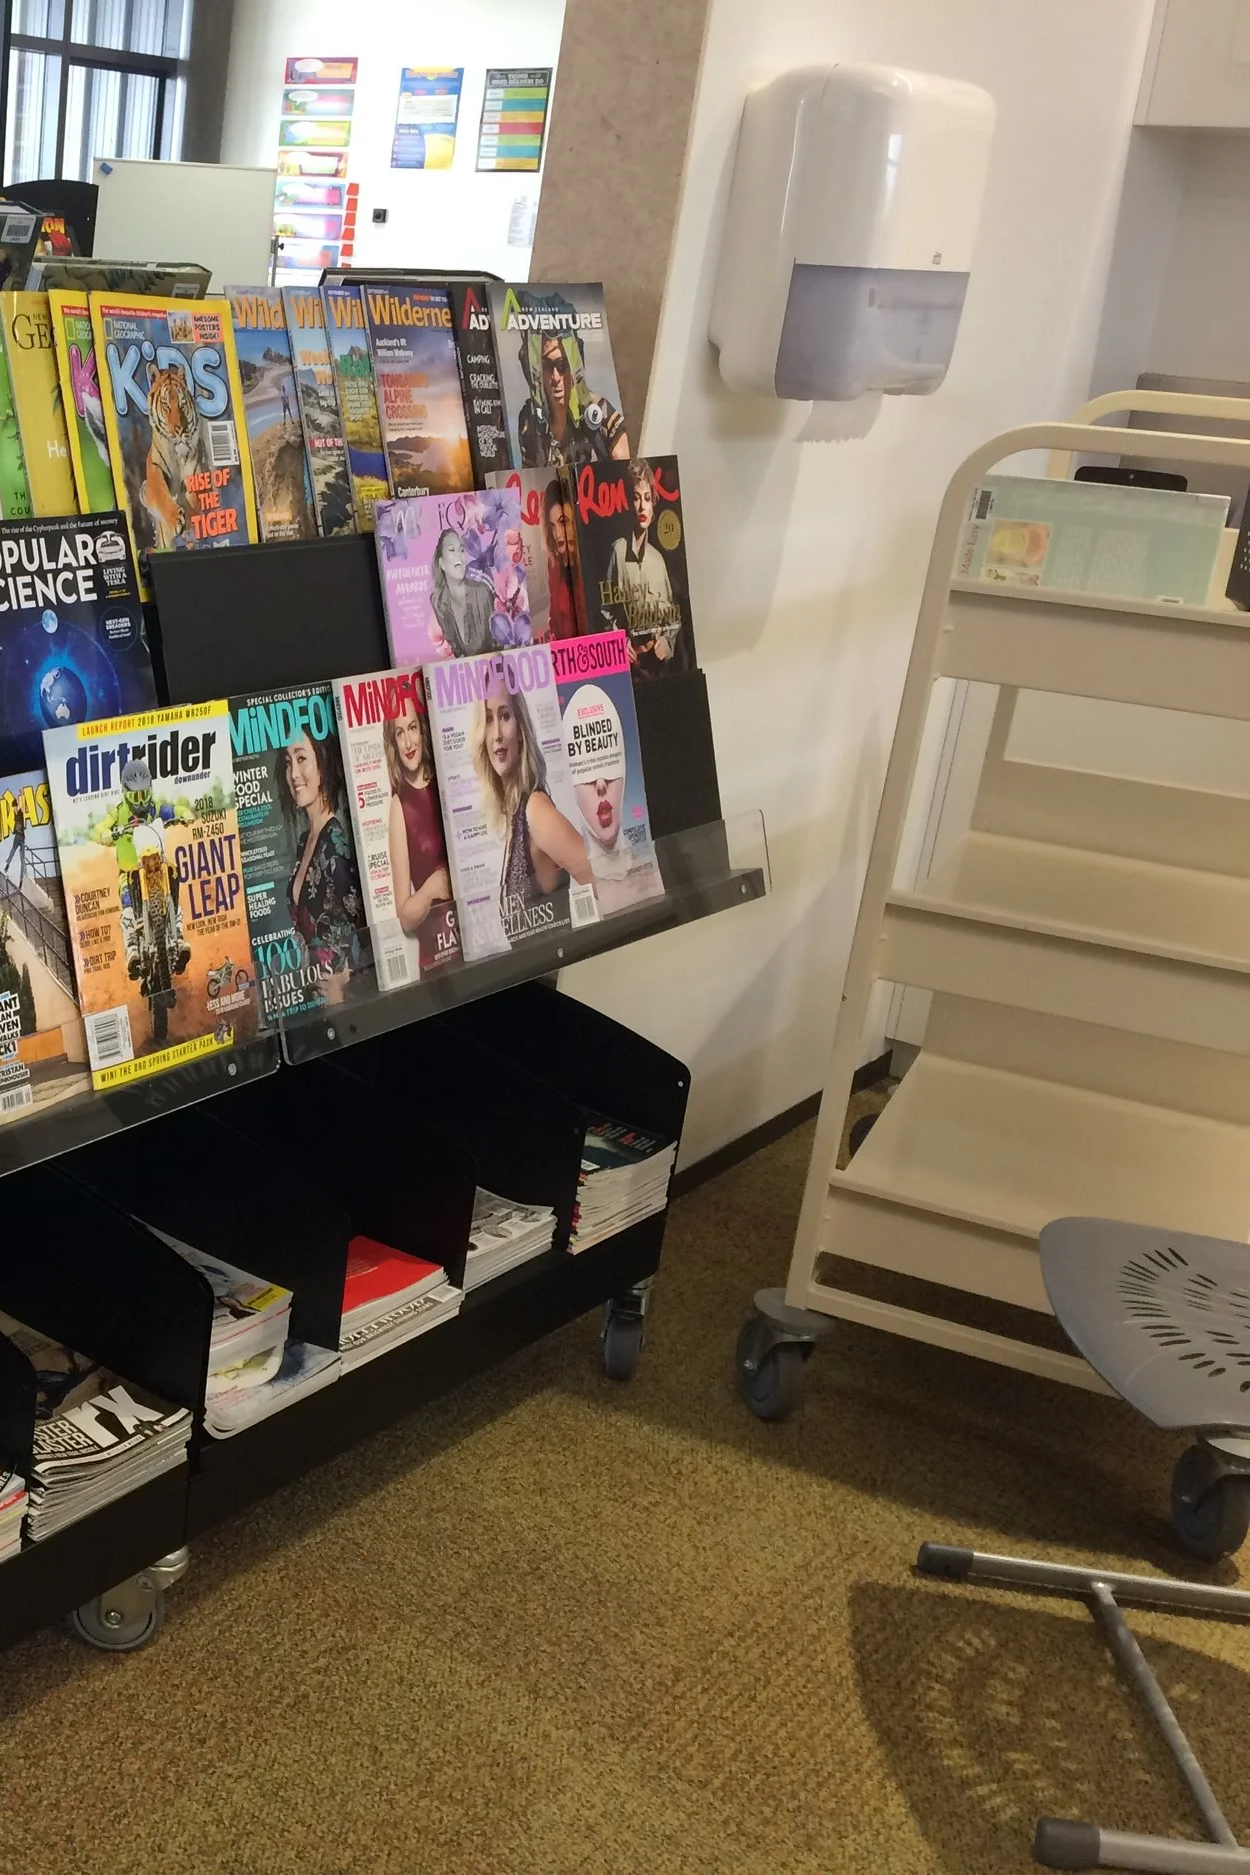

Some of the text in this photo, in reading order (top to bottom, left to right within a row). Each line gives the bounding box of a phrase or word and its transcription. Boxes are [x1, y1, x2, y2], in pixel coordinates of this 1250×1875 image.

[507, 313, 602, 331] ADVENTURE
[186, 468, 230, 491] RISE OF
[199, 490, 220, 509] THE
[578, 464, 679, 525] Remx
[191, 508, 238, 539] TIGER
[103, 567, 125, 575] LIVING
[105, 578, 126, 587] TESLA
[246, 688, 312, 706] SPECIAL COLLECTOR'S
[577, 704, 604, 716] EXCLUSIVE
[82, 725, 108, 737] LAUNCH
[110, 719, 135, 732] REPORT
[137, 716, 154, 729] 2018
[157, 710, 183, 725] YAMAHA
[573, 718, 613, 739] BLINDED
[568, 732, 619, 757] BY BEAUTY
[66, 730, 216, 798] dirtrider
[174, 770, 211, 785] downunder
[194, 796, 214, 812] 2018
[201, 808, 227, 825] SUZUKI
[192, 822, 225, 840] RM-Z450
[174, 834, 237, 884] GIANT
[80, 887, 111, 902] COURTNEY
[187, 873, 241, 921] LEAP
[247, 892, 268, 904] SUPER
[75, 901, 100, 914] DUNCAN
[249, 898, 277, 912] HEALING
[250, 907, 272, 919] FOODS
[251, 928, 296, 946] CELEBRATING
[255, 938, 300, 979] 100
[101, 1069, 118, 1083] WIN!
[120, 1064, 132, 1077] THE
[148, 1054, 171, 1068] SPRING
[172, 1045, 198, 1060] STARTER
[199, 1039, 214, 1050] PACK
